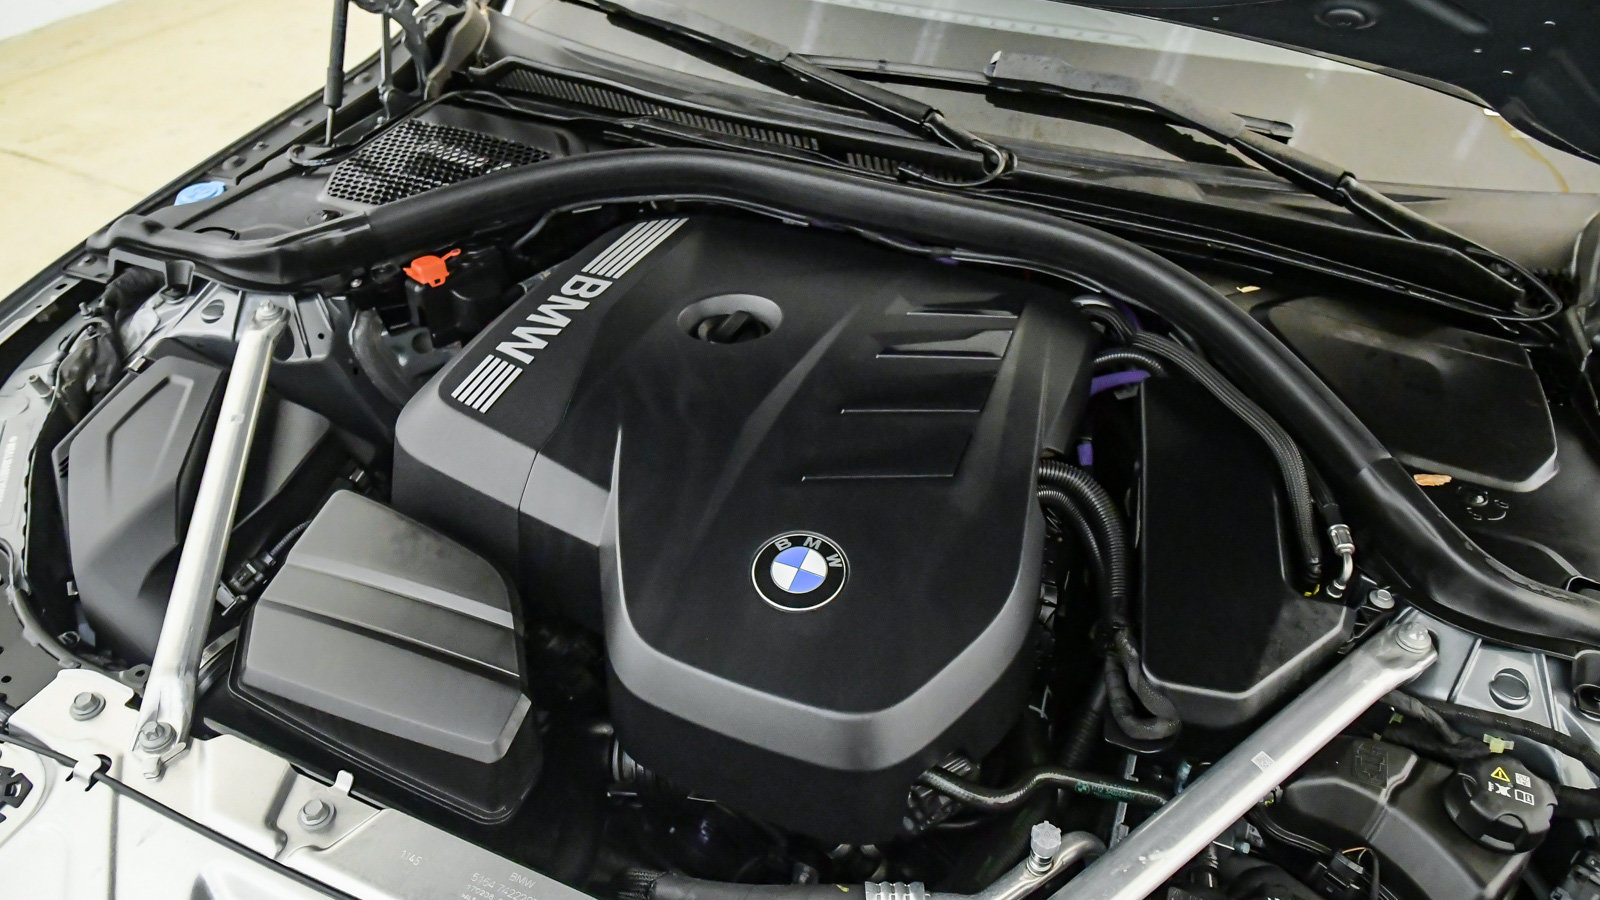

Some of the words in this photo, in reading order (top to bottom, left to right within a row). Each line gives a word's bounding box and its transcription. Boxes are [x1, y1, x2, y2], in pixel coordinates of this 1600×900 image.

[496, 274, 613, 364] BMW
[775, 536, 842, 568] BMW
[508, 872, 537, 889] BMW
